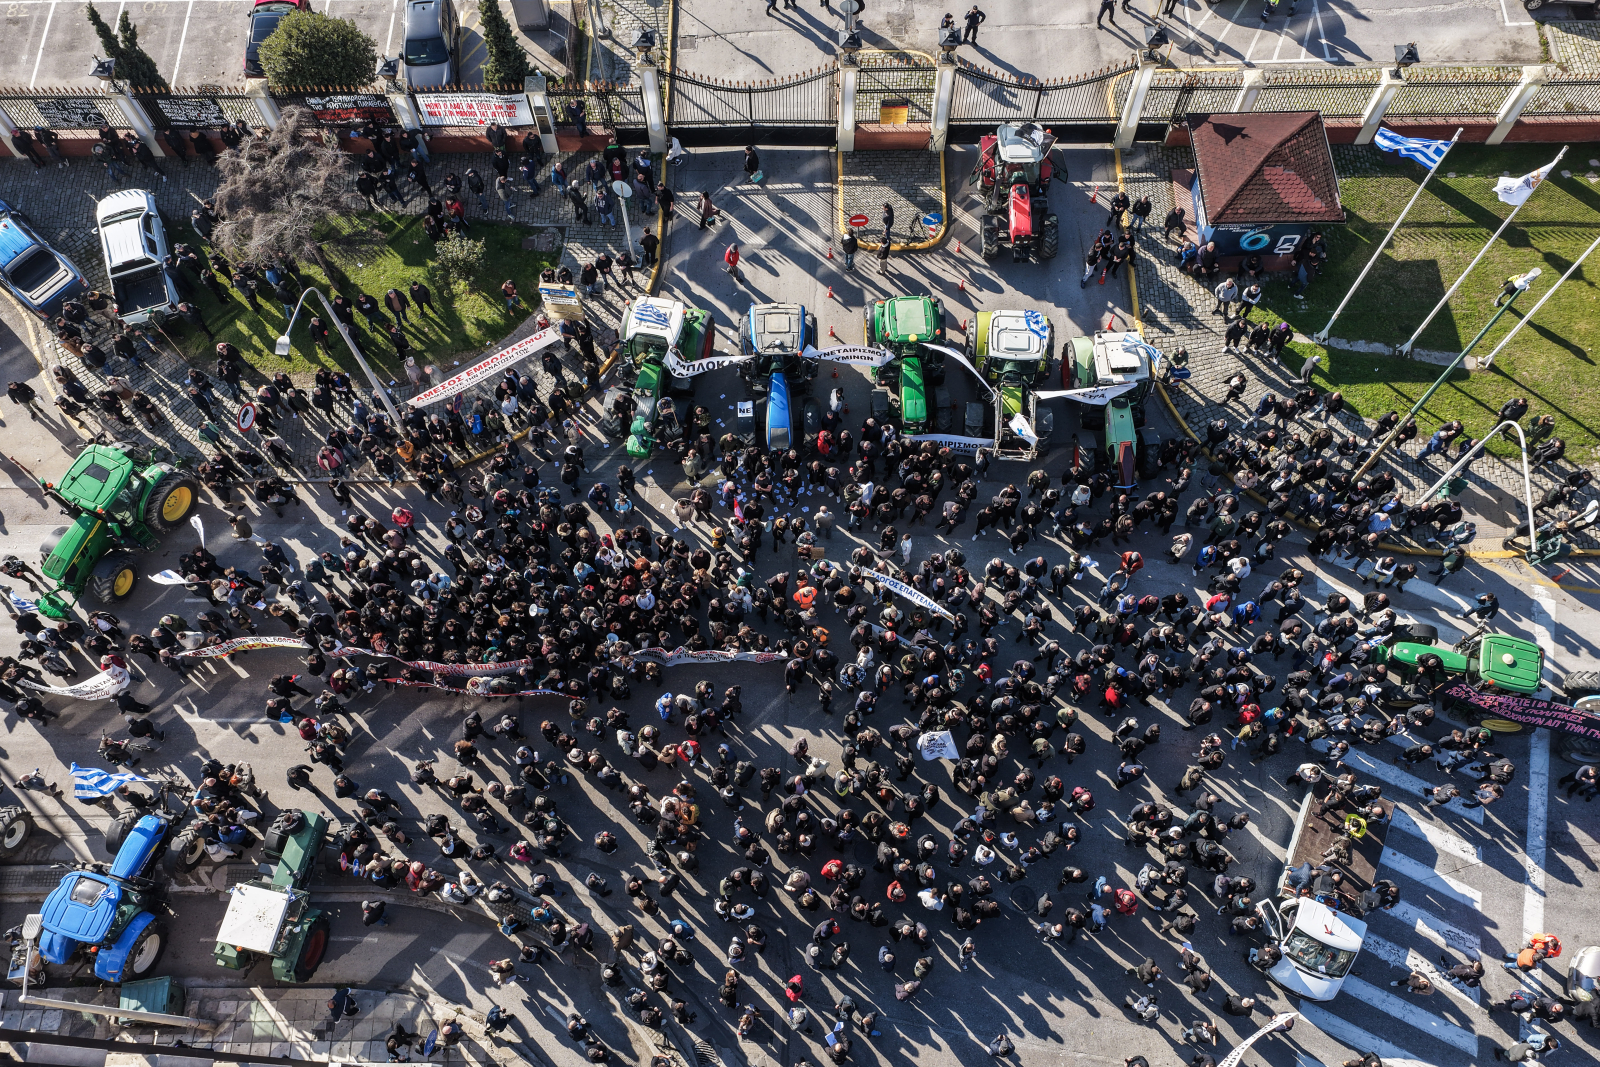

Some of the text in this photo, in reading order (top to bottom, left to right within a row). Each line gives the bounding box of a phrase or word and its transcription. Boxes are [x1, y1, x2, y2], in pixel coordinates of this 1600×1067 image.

[811, 347, 887, 359] ΥΝΕΤΑΙΡΙΣΜΟΣ
[416, 374, 465, 402] ΑΜΕΣΟΣ
[1490, 706, 1547, 725] ΔΙΩΧΝΟΥΝ
[1565, 722, 1588, 735] ΤΗΝ
